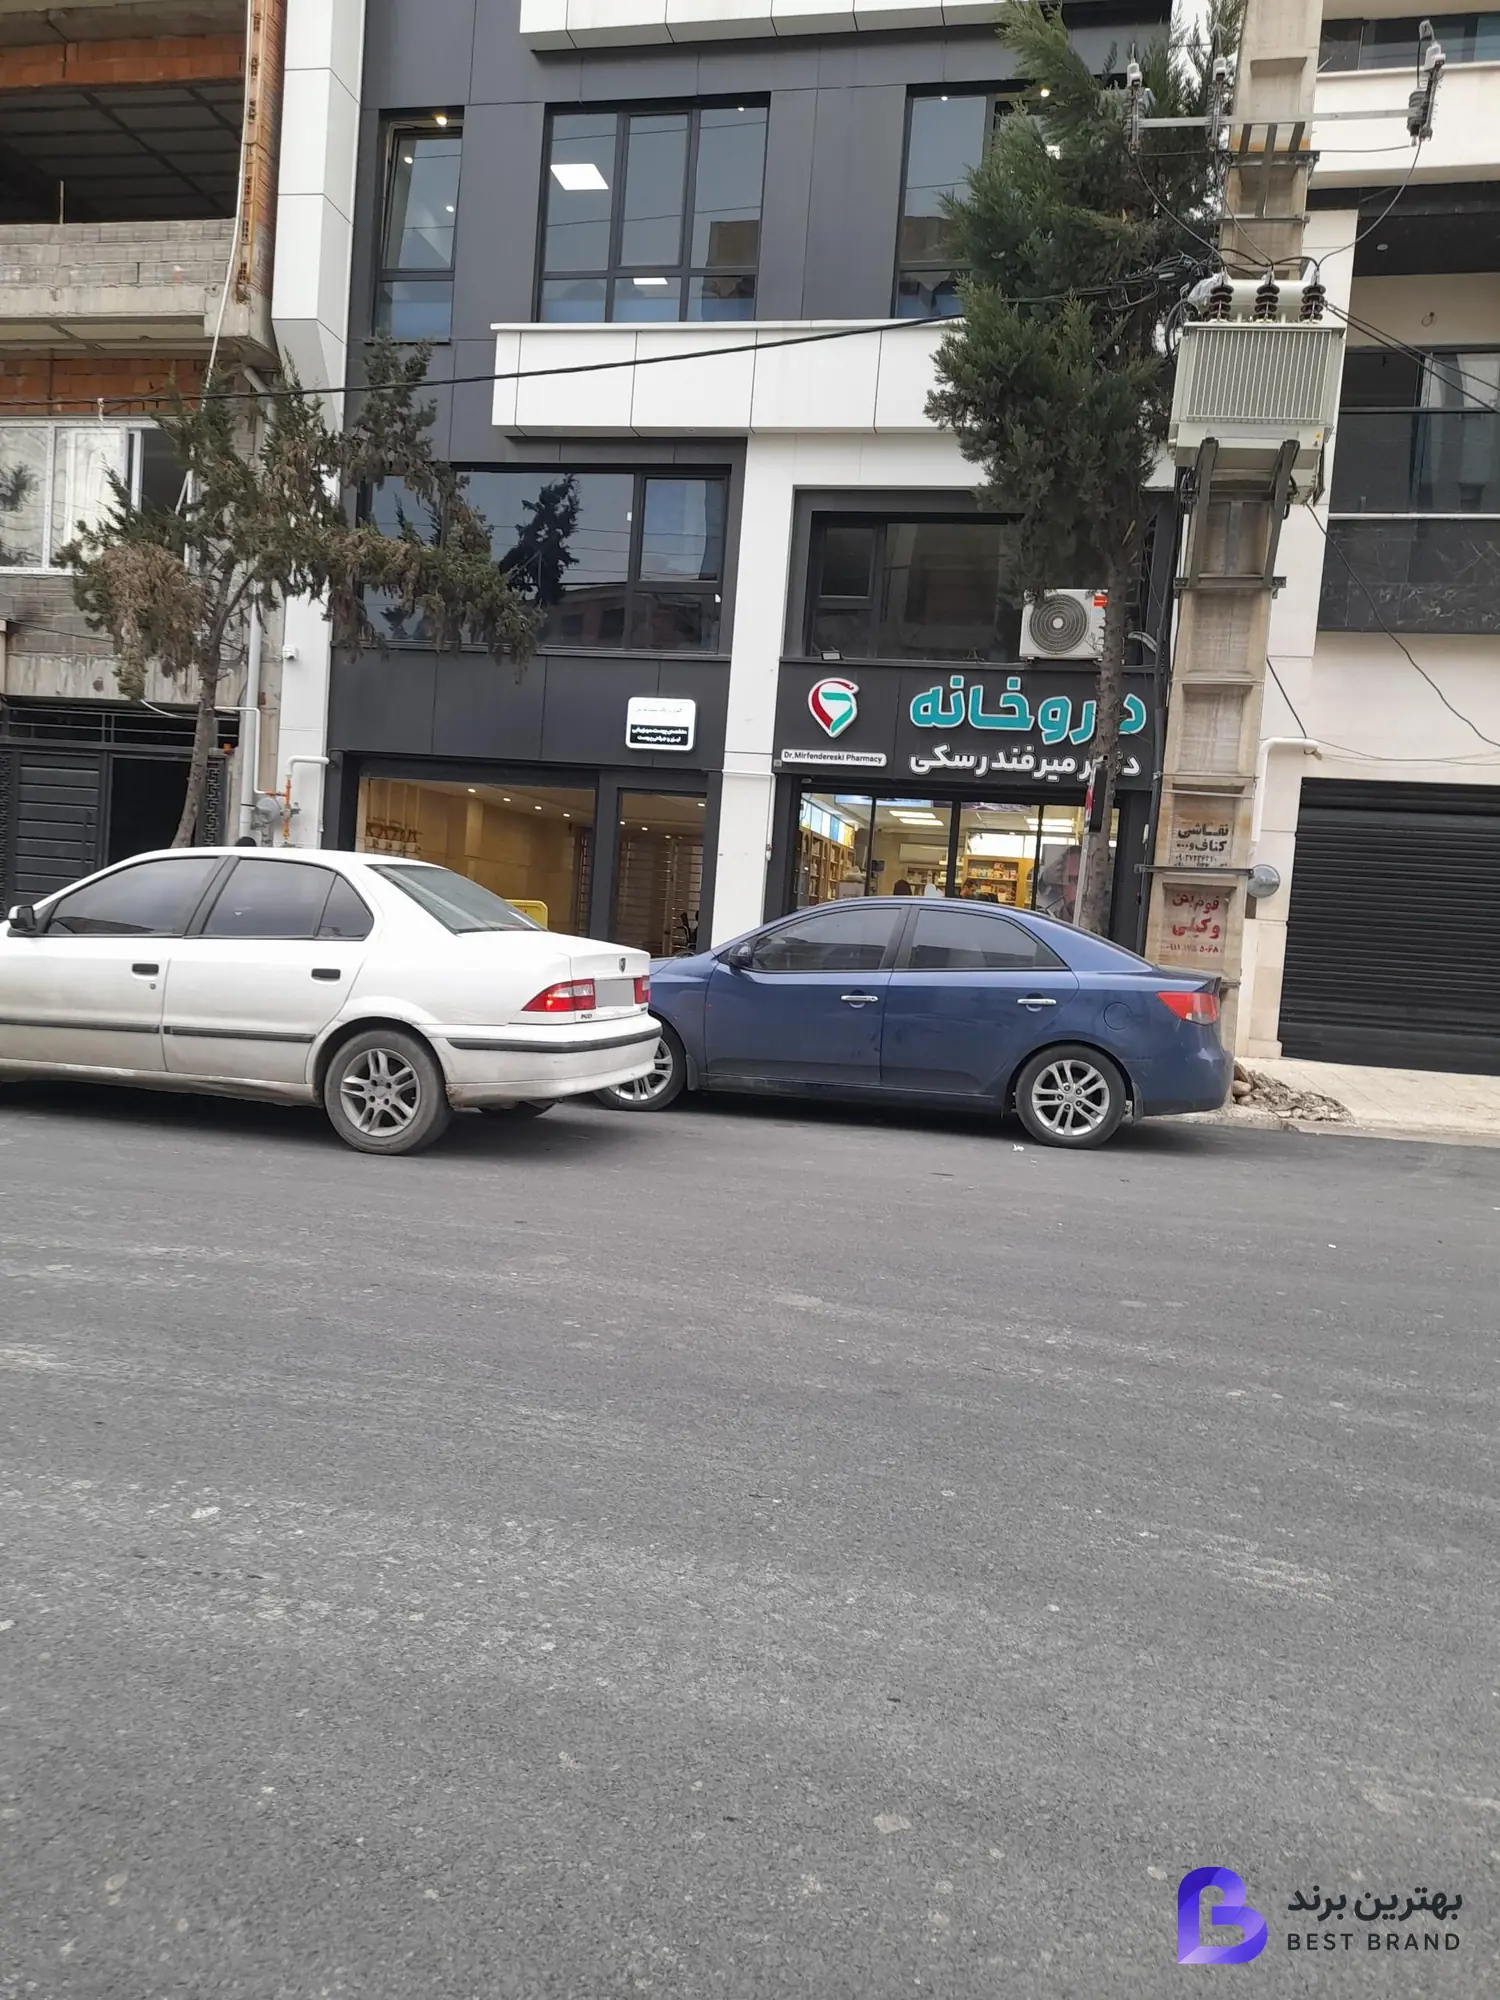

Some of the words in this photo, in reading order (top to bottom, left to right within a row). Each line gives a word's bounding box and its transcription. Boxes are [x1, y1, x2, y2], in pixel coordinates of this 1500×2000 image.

[909, 675, 1147, 745] دروخانه
[846, 754, 883, 764] Pharmacy
[909, 743, 1078, 783] میرفندرسکی
[1177, 823, 1229, 839] نقاشی
[1172, 917, 1221, 939] وکیلی
